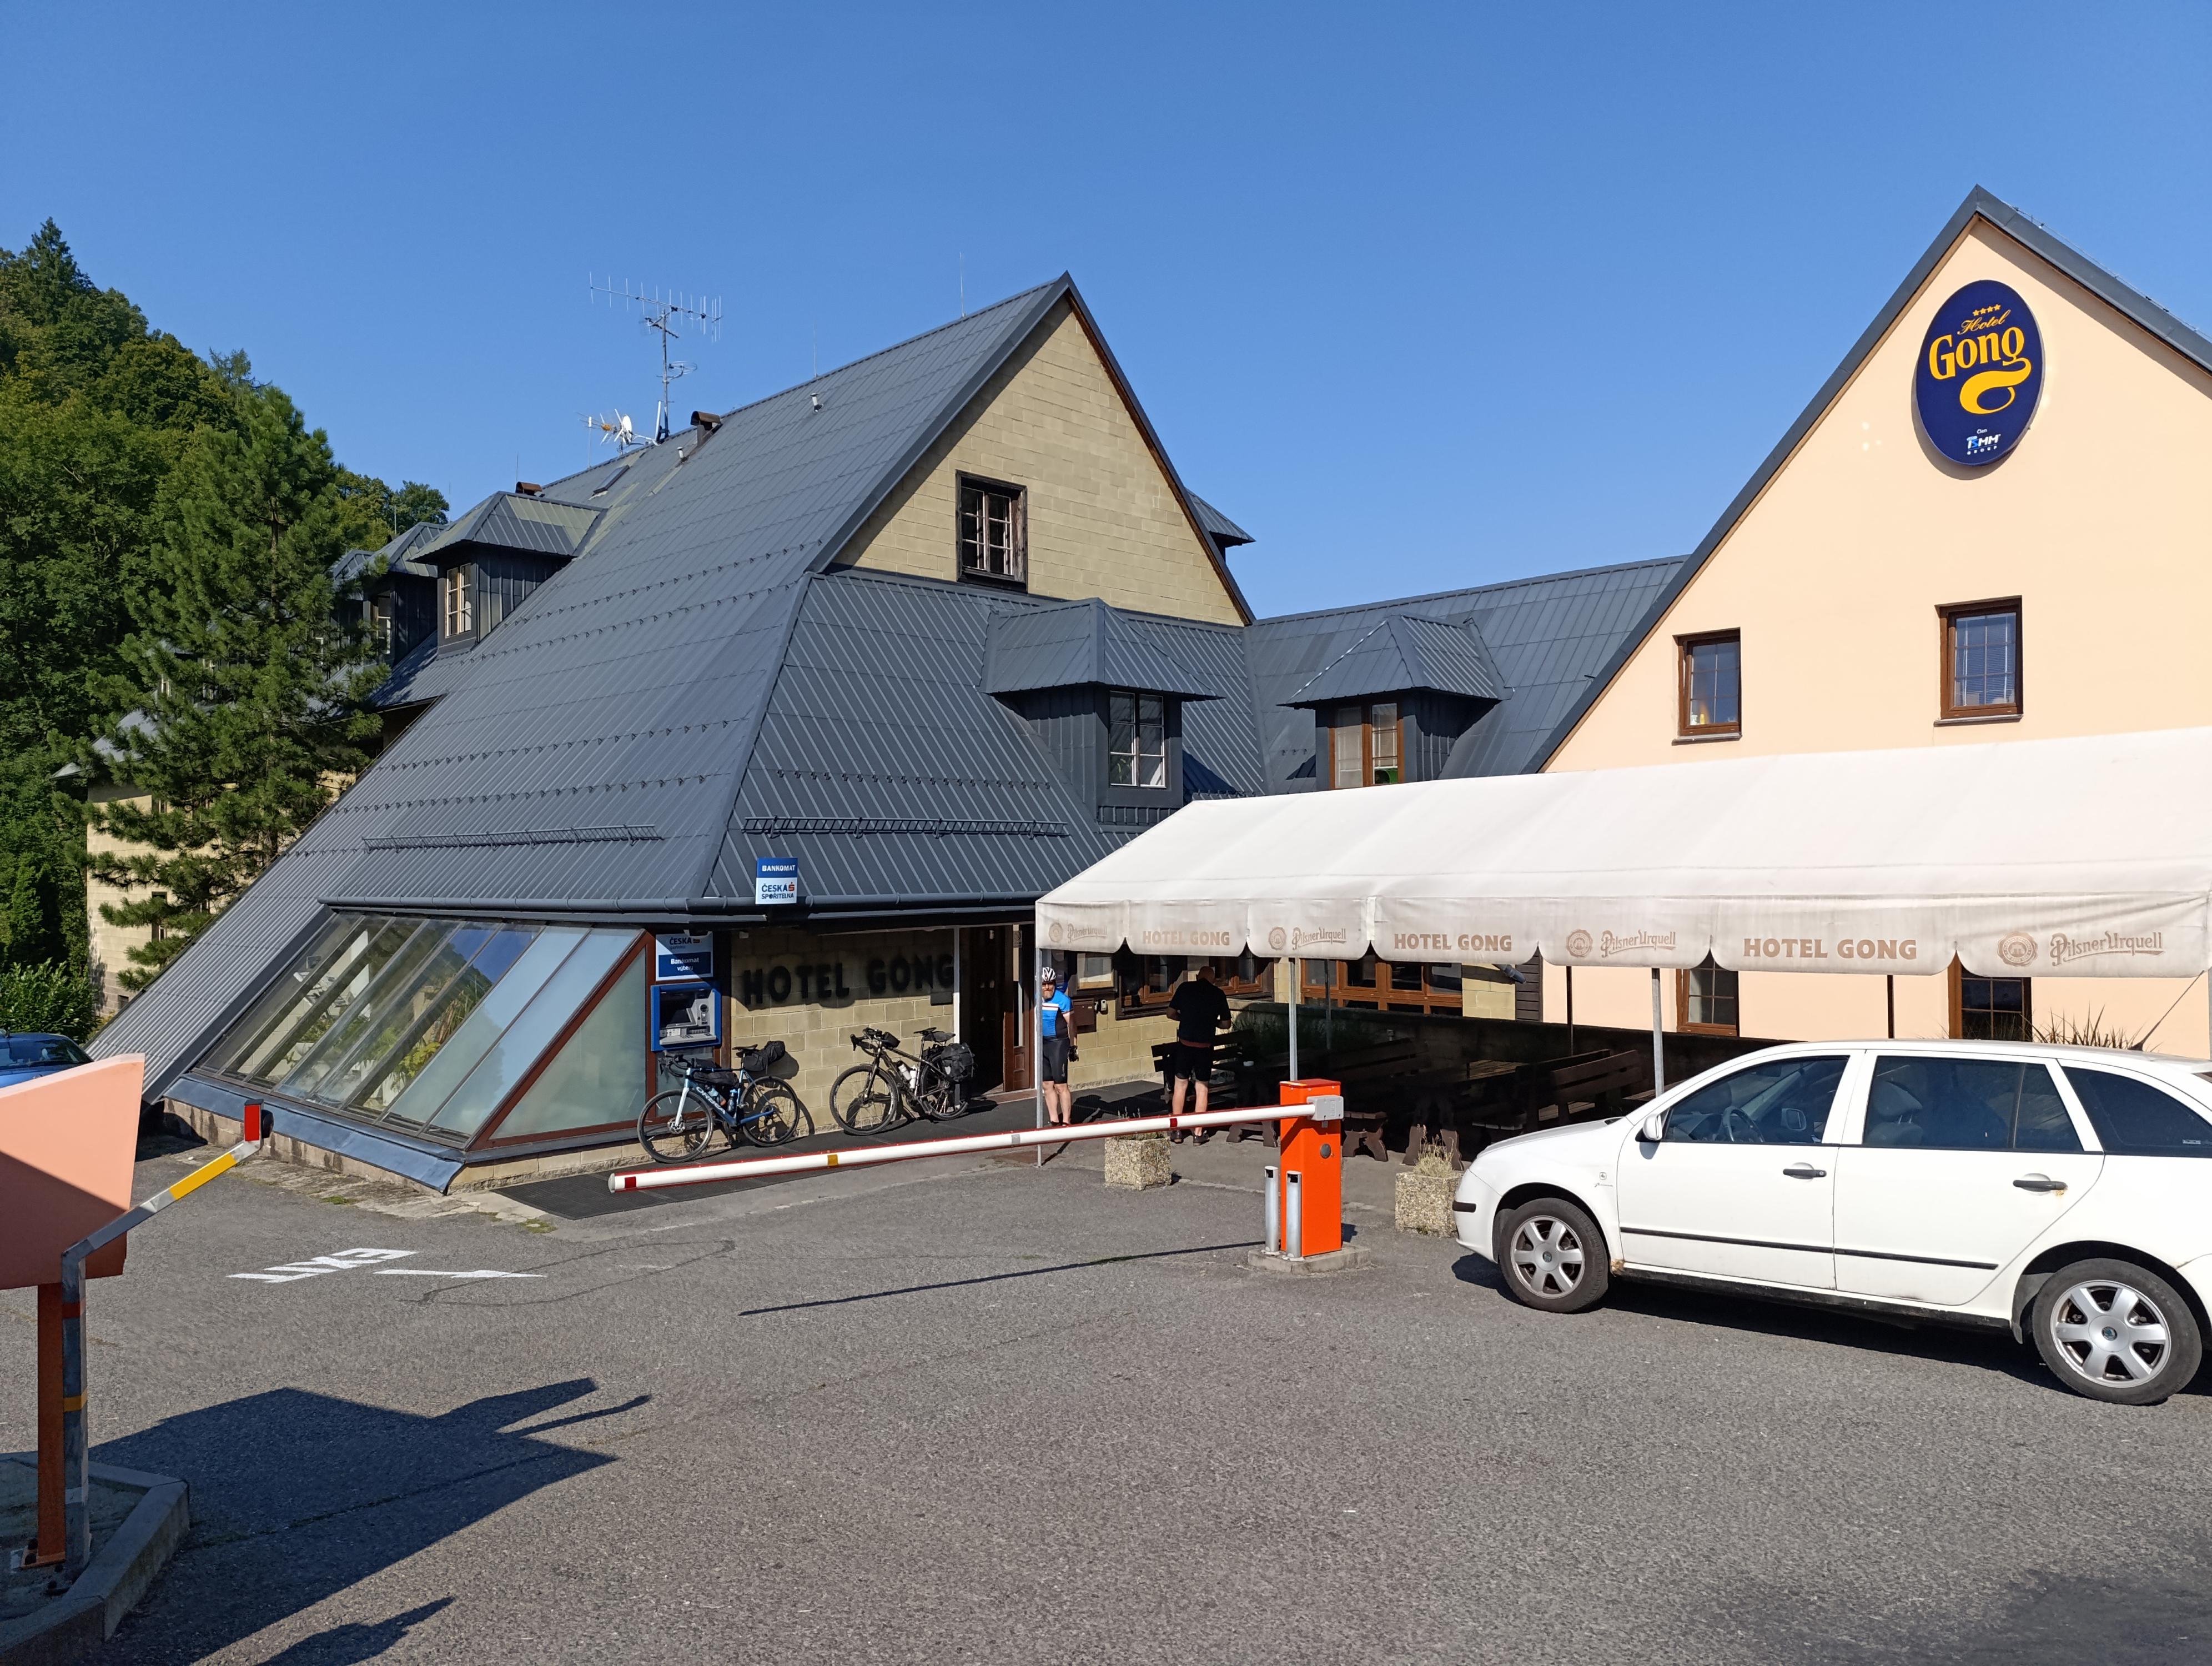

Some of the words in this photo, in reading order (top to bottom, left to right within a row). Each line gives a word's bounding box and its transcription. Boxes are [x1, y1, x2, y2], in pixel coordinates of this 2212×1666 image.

[1957, 309, 2011, 335] Hotel
[1929, 327, 2032, 414] Gong
[761, 884, 788, 892] ČESKÁ
[1143, 931, 1185, 945] HOTEL
[1190, 931, 1230, 946] GONG
[1291, 927, 1320, 951] Pilsner
[1319, 927, 1346, 944] Urquell
[1394, 934, 1452, 950] HOTEL
[1457, 934, 1512, 952] GONG
[1600, 930, 1638, 958] Pilsner
[1638, 929, 1676, 951] Urquell
[1743, 938, 1828, 958] HOTEL
[1837, 939, 1917, 960] GONG
[2050, 932, 2106, 966] Pilsner
[2104, 930, 2163, 956] Urquell
[742, 962, 850, 1005] HOTEL
[867, 954, 954, 994] GONG
[226, 1248, 419, 1283] EXIT
